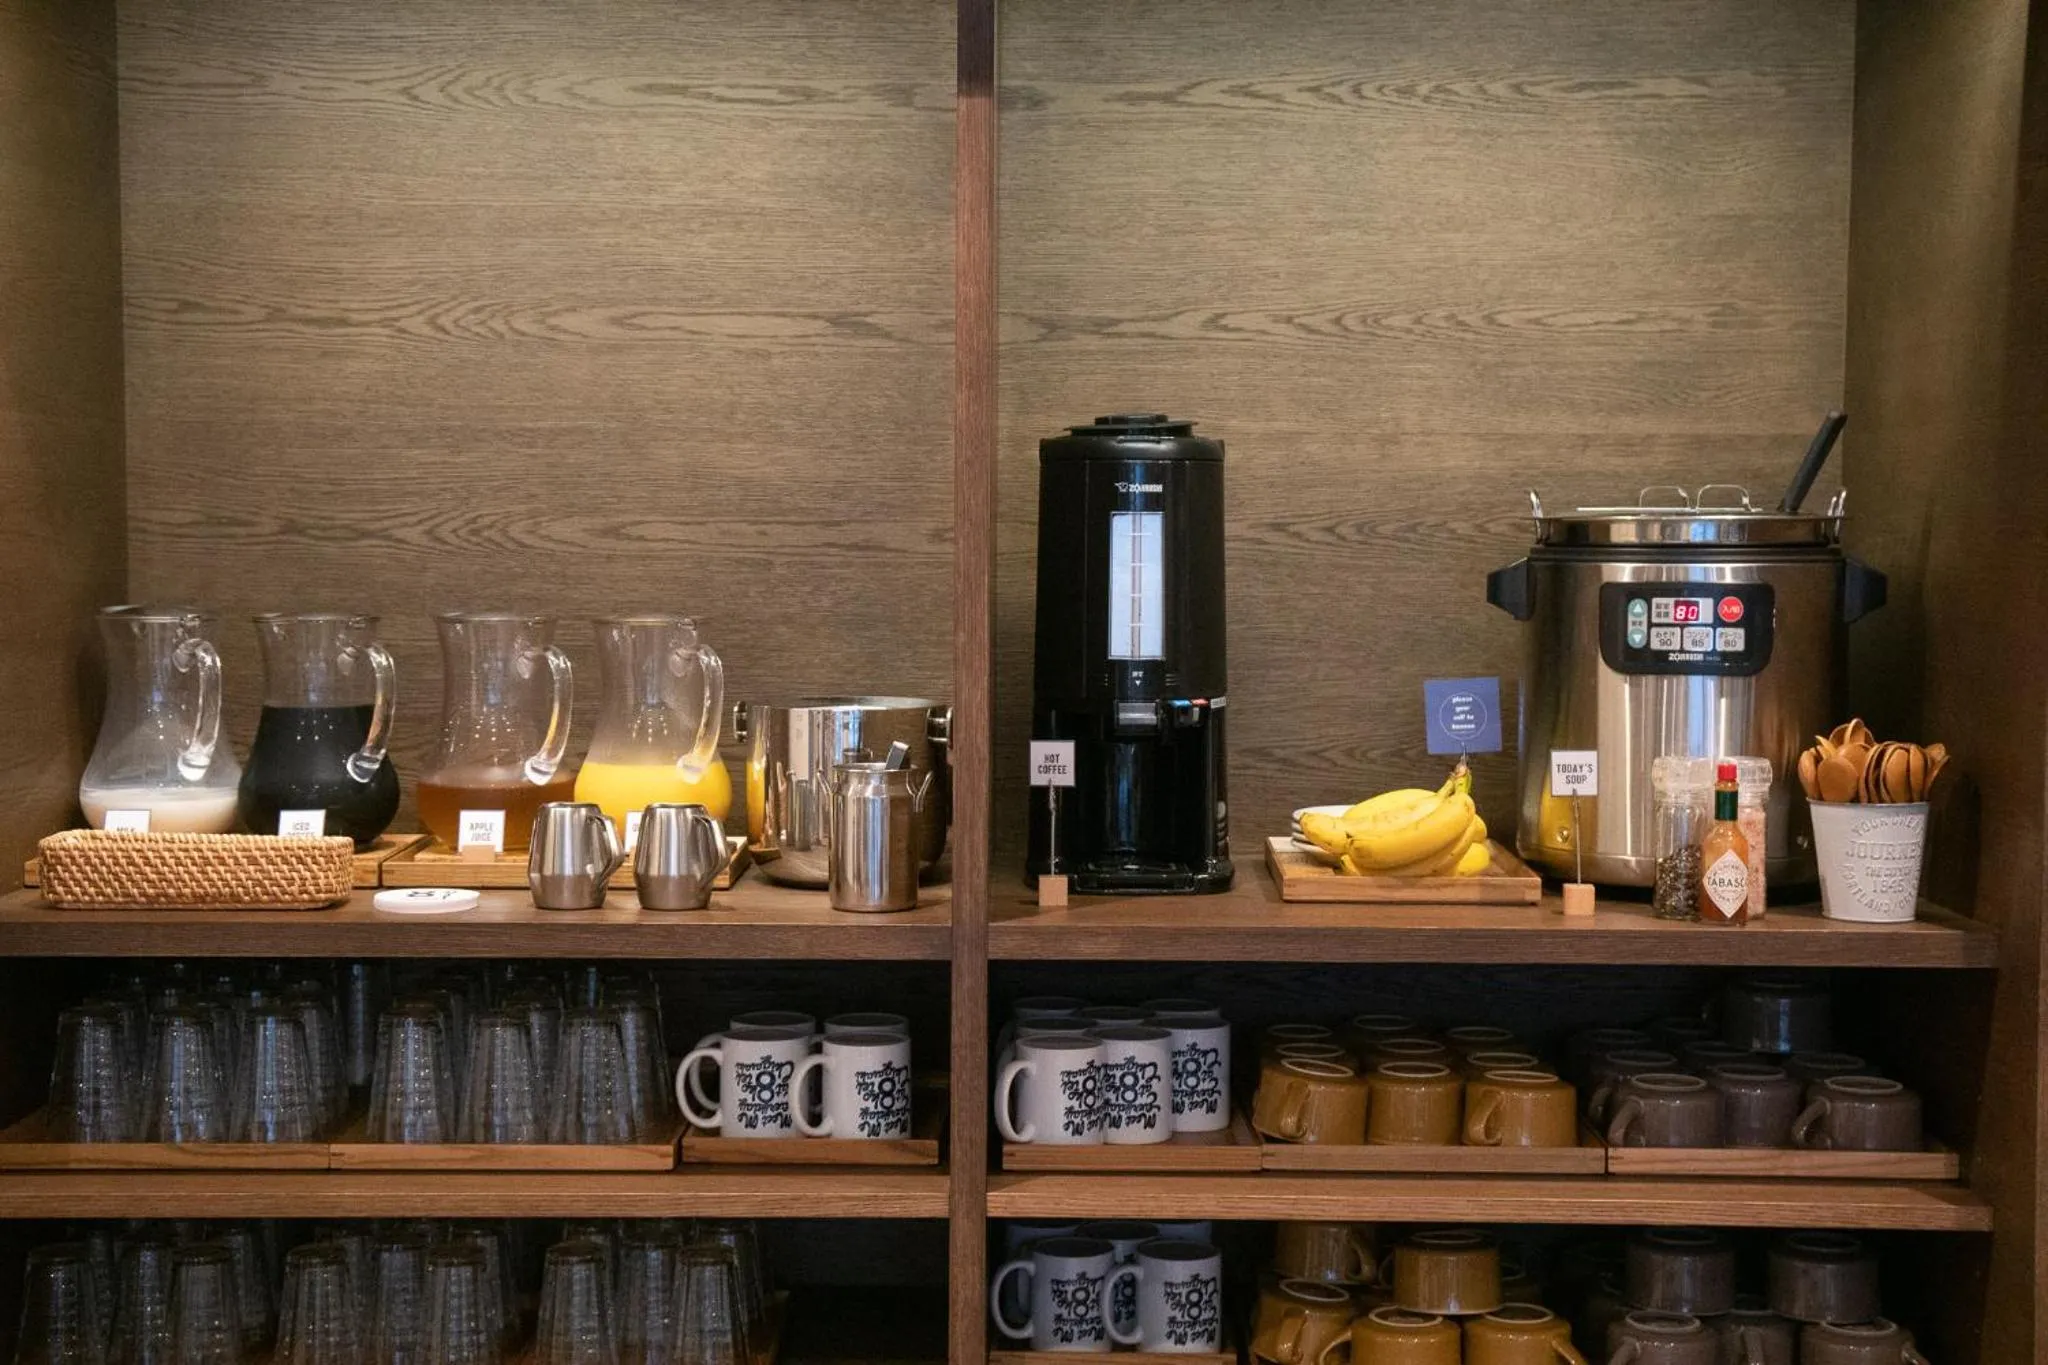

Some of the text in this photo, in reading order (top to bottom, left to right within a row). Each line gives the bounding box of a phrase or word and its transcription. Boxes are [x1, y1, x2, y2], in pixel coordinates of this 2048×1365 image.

[1676, 605, 1698, 620] 80
[1659, 638, 1672, 647] 90
[1044, 753, 1060, 763] HOT
[1037, 764, 1067, 775] COFFEE
[1556, 763, 1593, 773] TODAY'S
[1565, 774, 1587, 785] SOUP
[469, 822, 496, 832] APPLE
[470, 832, 492, 842] JUICE
[1181, 1058, 1201, 1089] 8
[756, 1071, 776, 1104] 8
[878, 1077, 896, 1110] 8
[1082, 1075, 1097, 1109] 8
[1119, 1072, 1139, 1104] 8
[737, 1112, 758, 1130] Me
[858, 1120, 881, 1138] Me
[1063, 1120, 1085, 1137] Me
[1125, 1113, 1157, 1130] Meet
[1072, 1287, 1090, 1317] 8
[1185, 1289, 1203, 1320] 8
